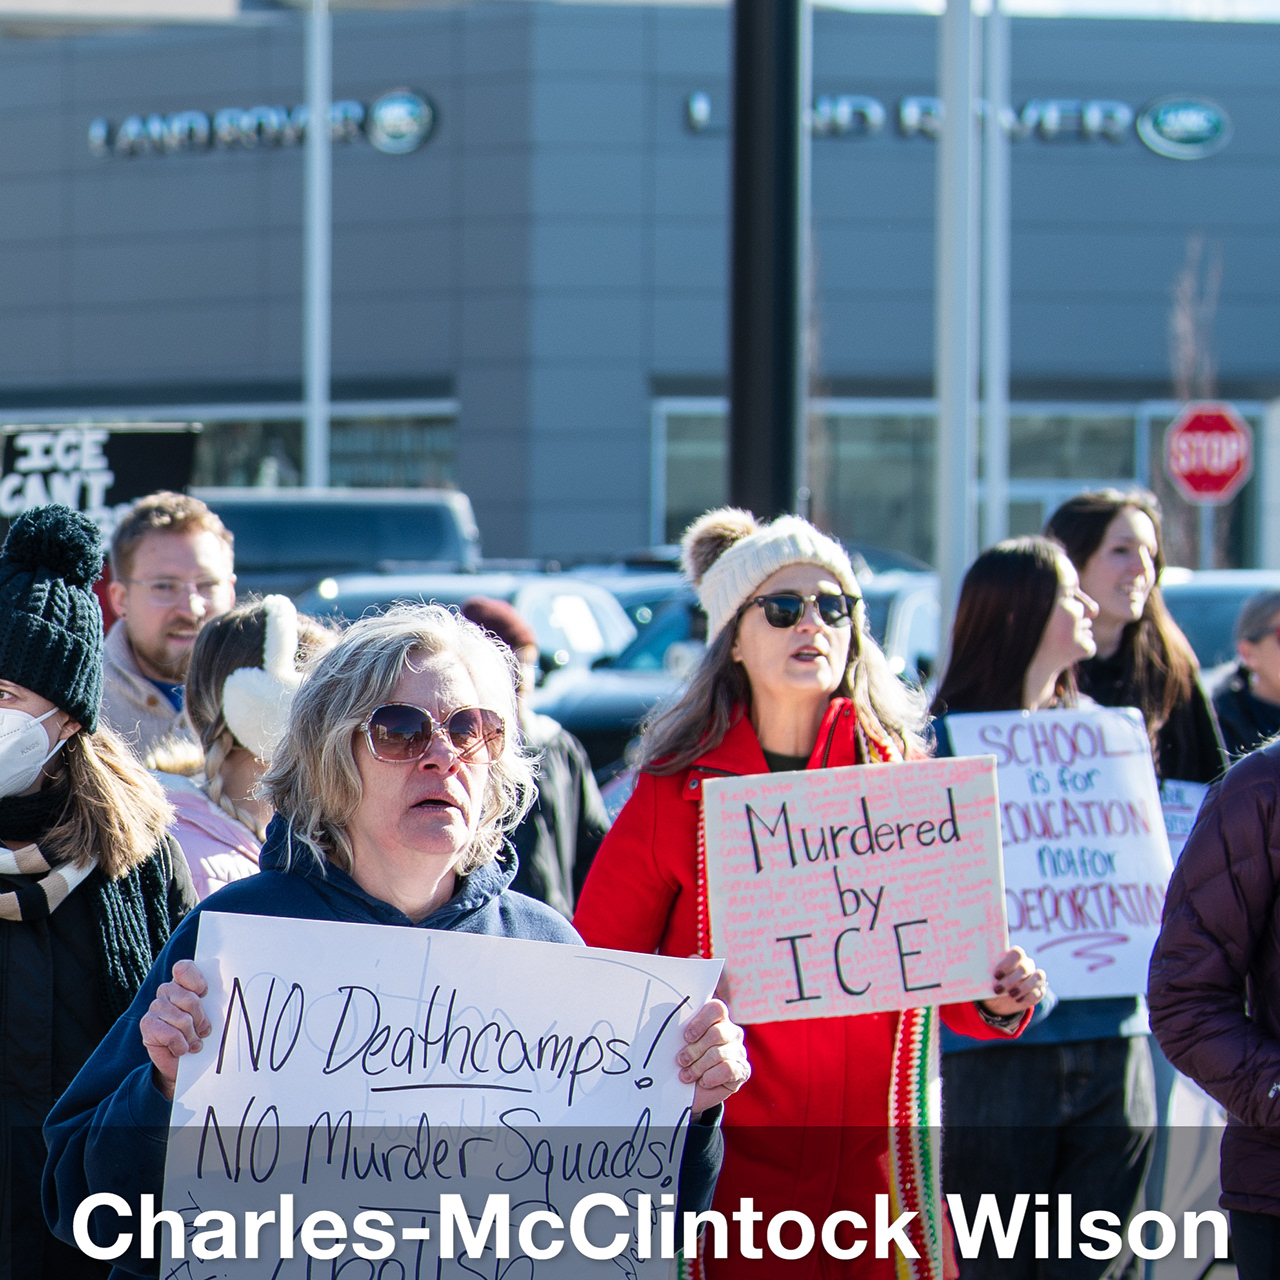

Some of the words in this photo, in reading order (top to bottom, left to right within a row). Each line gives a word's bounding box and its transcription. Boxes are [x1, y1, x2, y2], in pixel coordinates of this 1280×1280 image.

[689, 90, 887, 137] LND
[13, 429, 112, 471] ICE
[1170, 430, 1247, 475] STOP
[978, 720, 1132, 769] SCHOOL
[745, 786, 961, 874] Murdered
[1000, 797, 1152, 848] DUCATION
[833, 865, 885, 931] by
[775, 918, 942, 1004] ICE
[215, 977, 305, 1075] NO
[322, 984, 692, 1107] Deathcamps!
[196, 1096, 280, 1183] NO
[301, 1106, 493, 1185] Murder
[495, 1106, 694, 1206] Squads!
